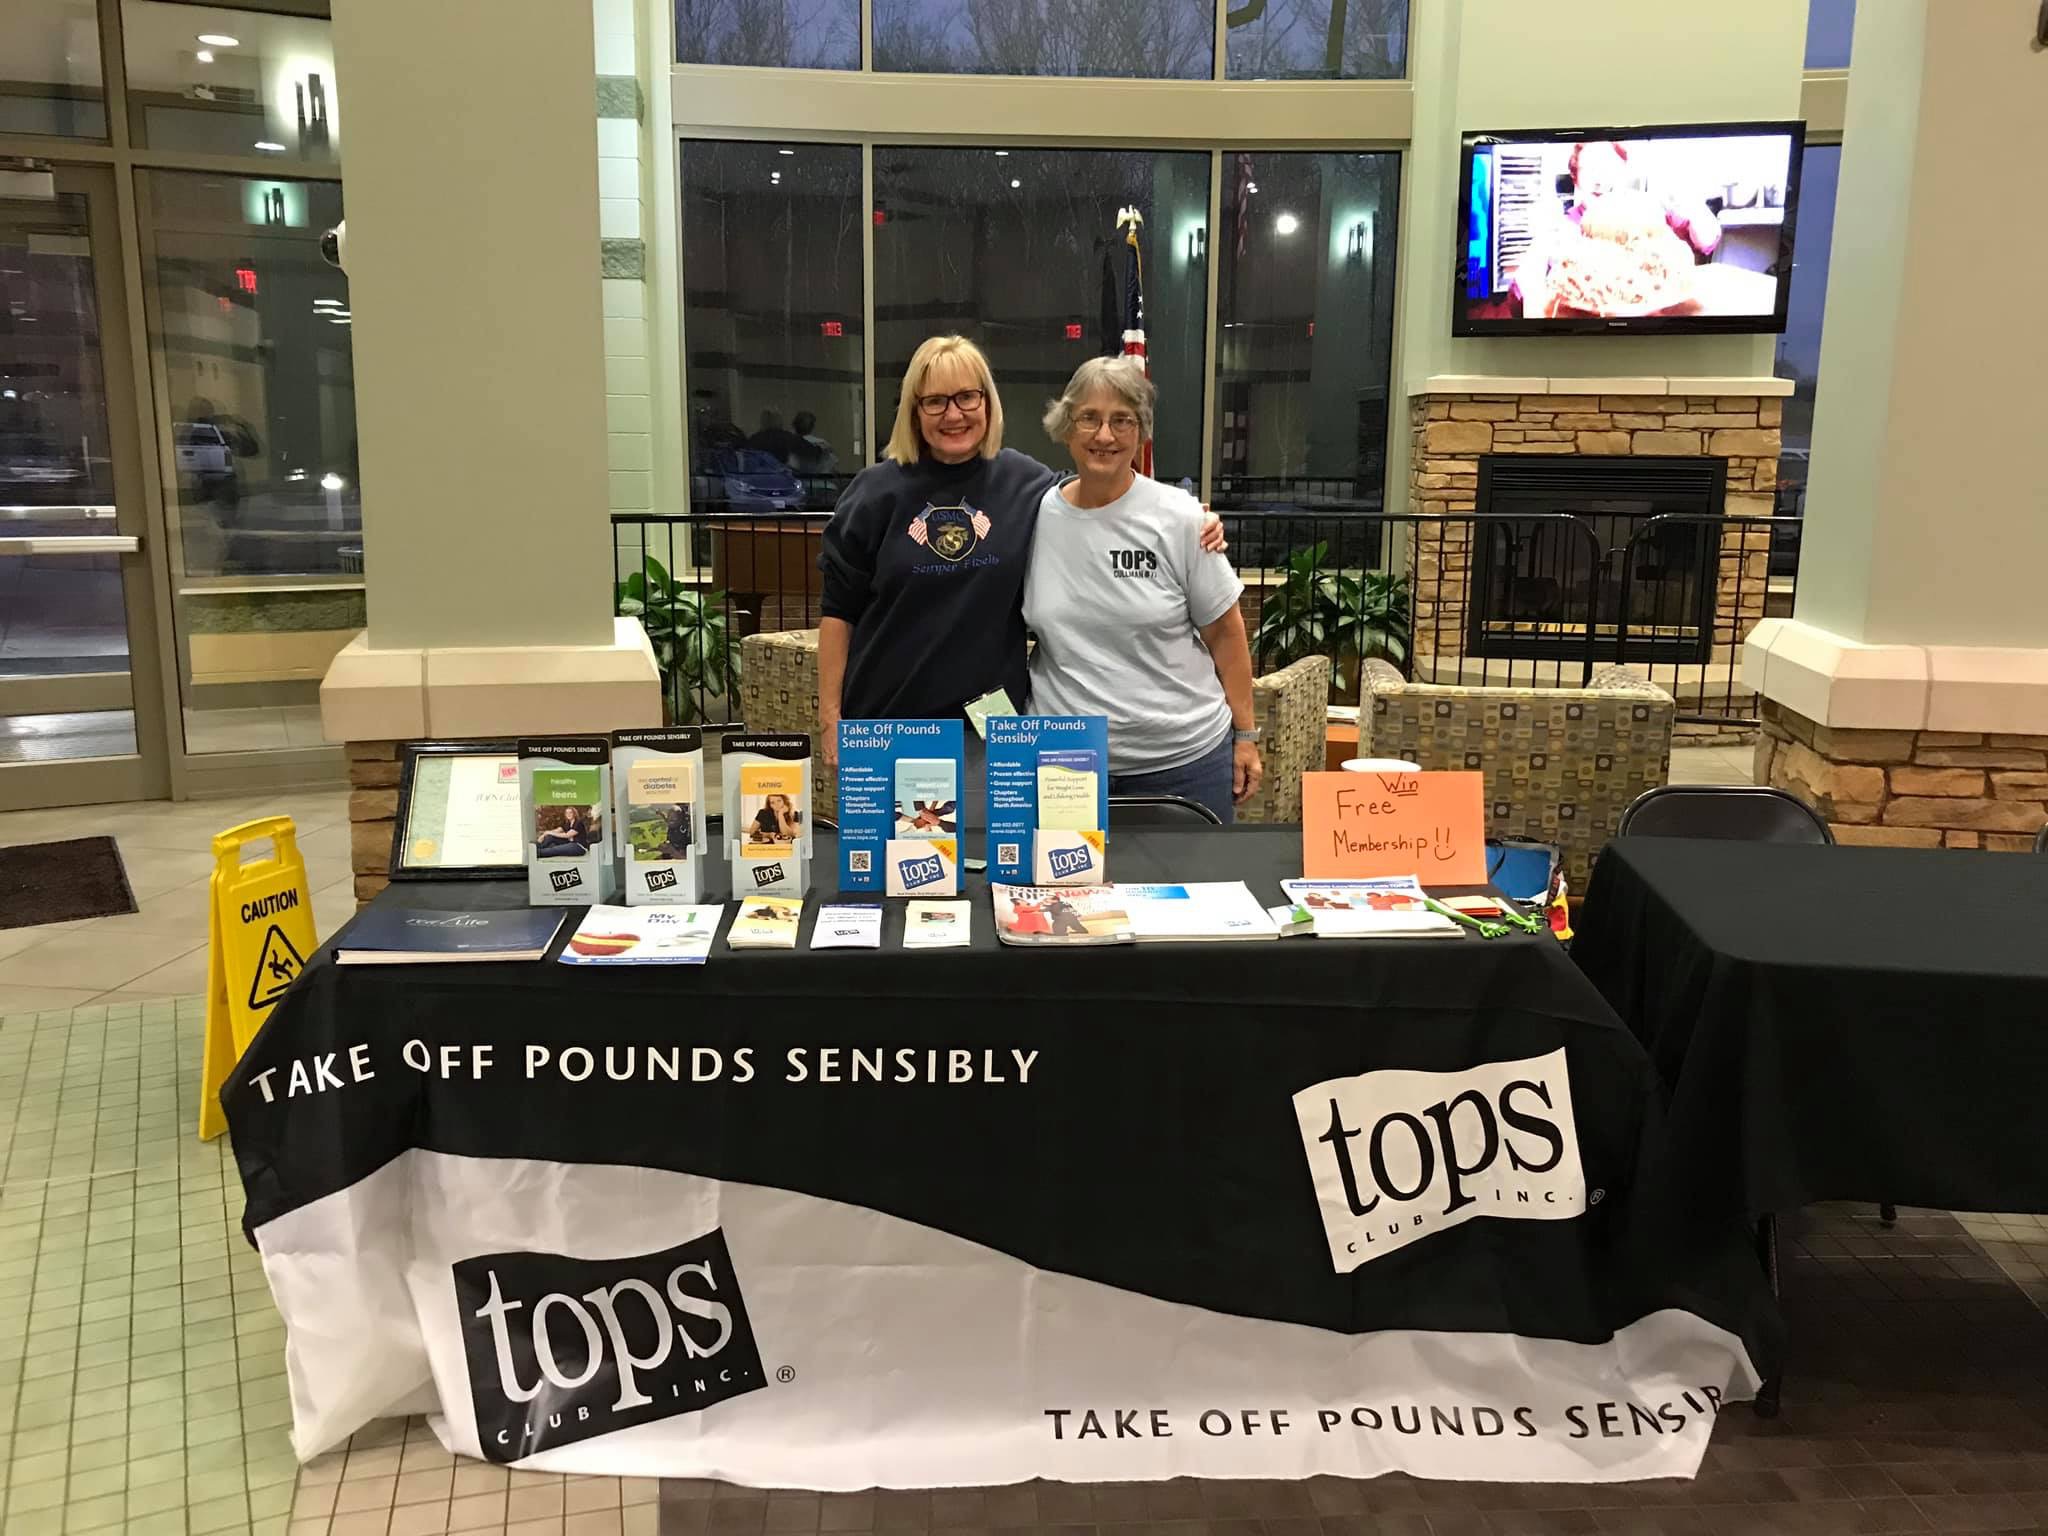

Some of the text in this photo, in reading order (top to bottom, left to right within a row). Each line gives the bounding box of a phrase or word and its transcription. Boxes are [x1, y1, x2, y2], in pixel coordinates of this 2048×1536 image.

[1109, 550, 1157, 570] TOPS
[842, 723, 941, 735] Take Off Pounds
[990, 719, 1086, 730] Take Off Pounds
[842, 737, 891, 751] Sensibly
[990, 733, 1038, 746] Sensibly
[643, 782, 676, 790] diabetes
[1377, 772, 1419, 794] Win
[552, 791, 577, 799] teens
[1336, 789, 1397, 820] Free
[1050, 848, 1088, 871] tops
[552, 870, 579, 887] tops
[647, 871, 675, 888] tops
[755, 865, 782, 883] tops
[902, 858, 939, 882] tops
[1055, 886, 1112, 898] News
[241, 888, 299, 924] CAUTION
[686, 912, 697, 924] 1
[248, 1039, 1039, 1104] TAKE OFF POUNDS SENSIBLY
[1318, 1080, 1564, 1217] tops
[1347, 1214, 1423, 1254] CLUB
[1495, 1189, 1574, 1203] INC.
[475, 1260, 733, 1412] tops
[497, 1405, 590, 1445] CLUB
[672, 1368, 749, 1398] INC.
[1044, 1409, 1173, 1440] TAKE
[1199, 1409, 1290, 1437] OFF
[1317, 1405, 1538, 1437] POUNDS
